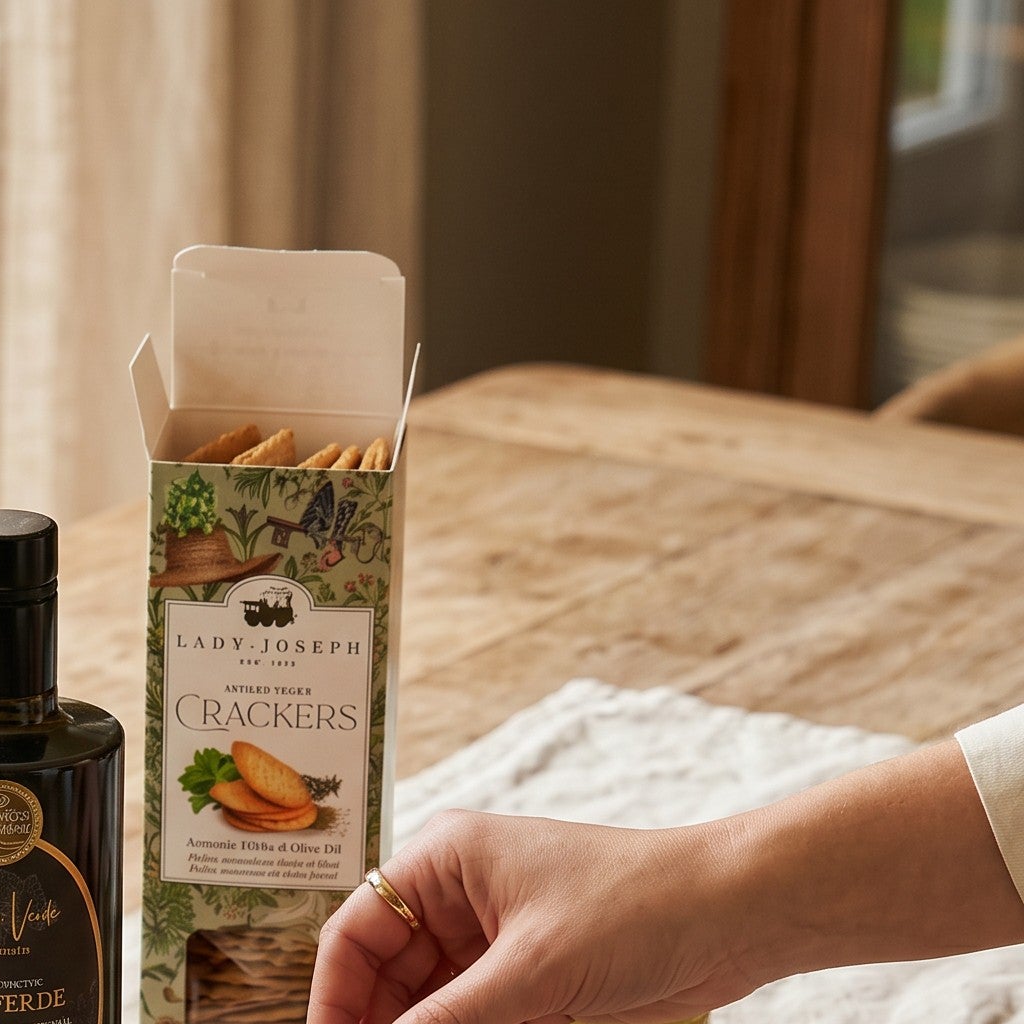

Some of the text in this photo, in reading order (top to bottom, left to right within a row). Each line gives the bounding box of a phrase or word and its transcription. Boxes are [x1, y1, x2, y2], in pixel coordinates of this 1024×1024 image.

[176, 635, 360, 655] LADY JOSEPH
[176, 693, 358, 732] CRACKERS
[290, 842, 320, 854] Olive
